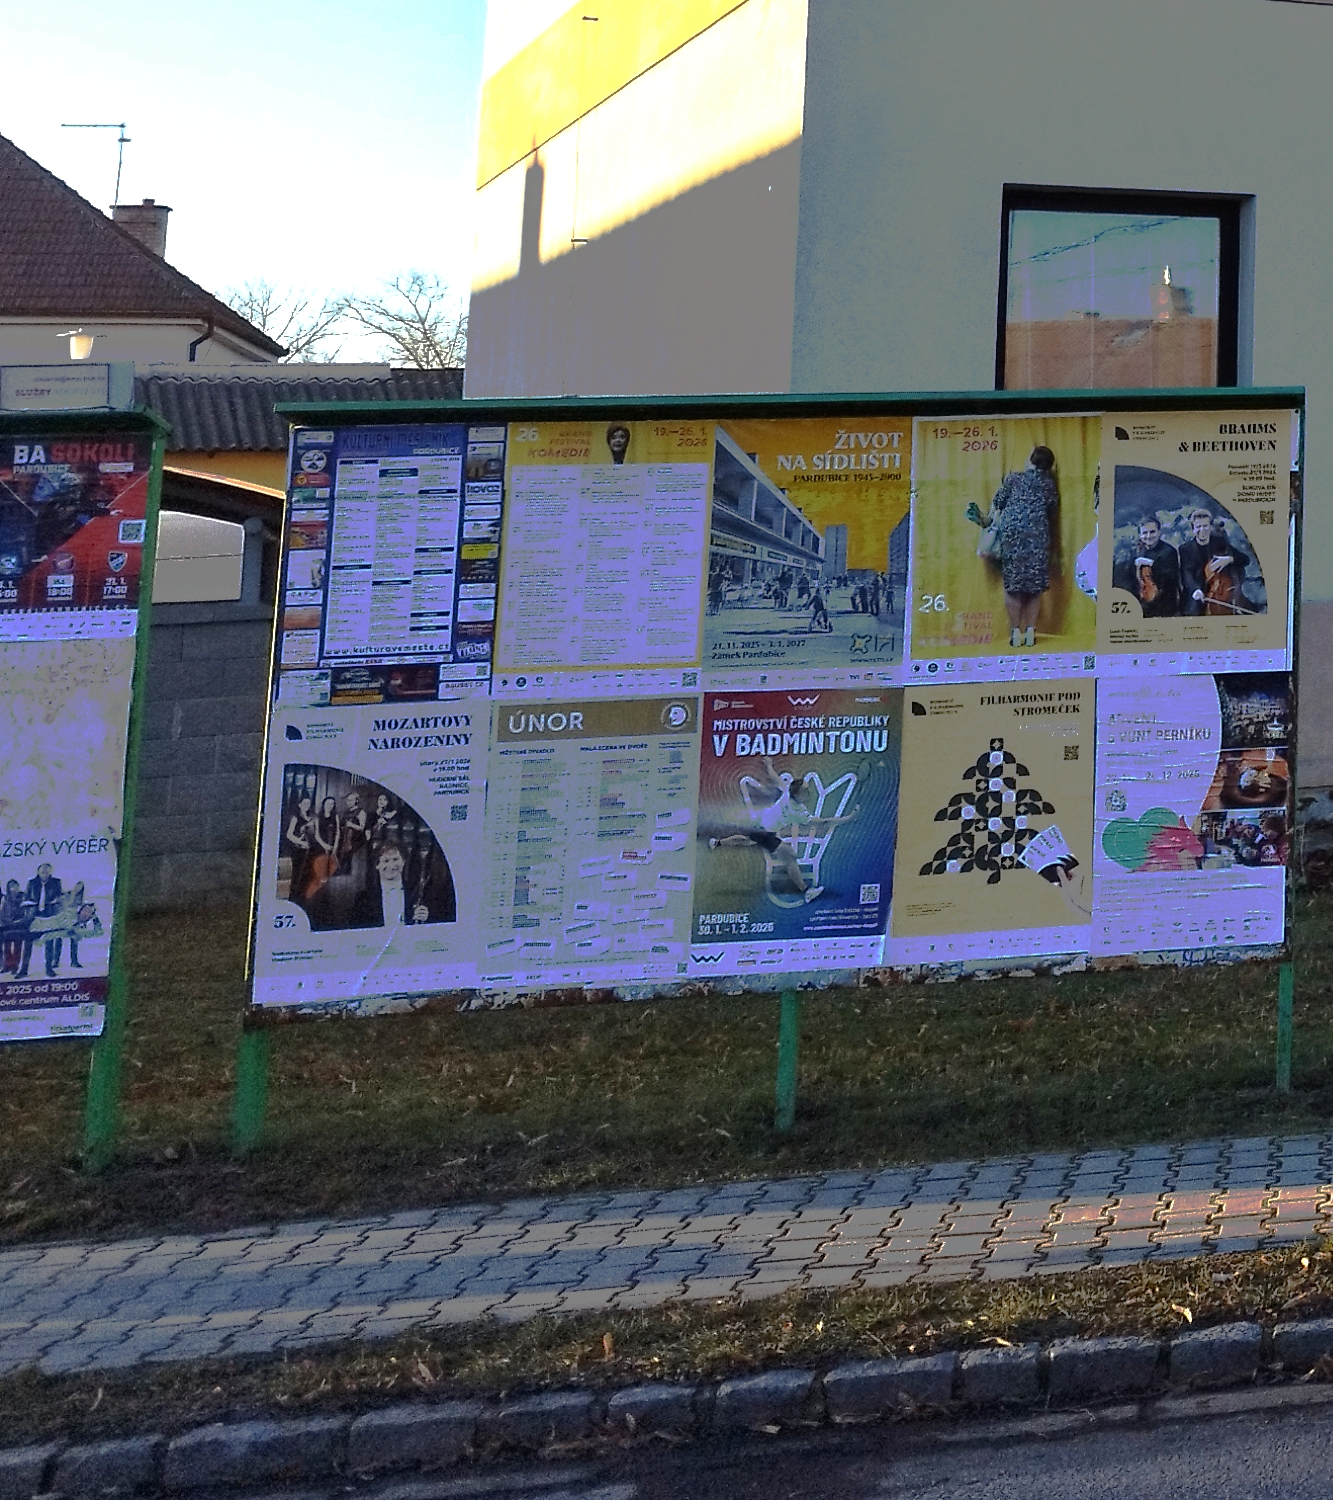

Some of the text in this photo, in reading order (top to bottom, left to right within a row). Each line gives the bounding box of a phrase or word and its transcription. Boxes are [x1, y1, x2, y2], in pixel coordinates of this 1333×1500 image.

[1219, 423, 1277, 435] BRAHMS
[834, 429, 904, 450] ŽIVOT
[1178, 440, 1277, 453] & BEETHOVEN
[13, 445, 46, 465] BA
[527, 448, 590, 458] KOMEDIE
[777, 450, 902, 471] NA SÍDLIŠTI
[793, 473, 849, 483] PARDUBICE
[980, 692, 1081, 706] FILHARMONIE POD
[1013, 703, 1081, 717] STROMEČEK
[373, 714, 473, 732] MOZARTOVY
[508, 708, 585, 735] ÚNOR
[713, 714, 889, 732] MISTROVSTVÍ ČESKÉ REPUBLIKY
[1156, 726, 1211, 741] PERNÍKU
[368, 733, 473, 751] NAROZENINY
[713, 730, 889, 757] V BADMINTONU
[52, 835, 109, 855] VÝBĚR
[699, 913, 750, 925] PARDUBICE
[51, 981, 79, 991] 19:00
